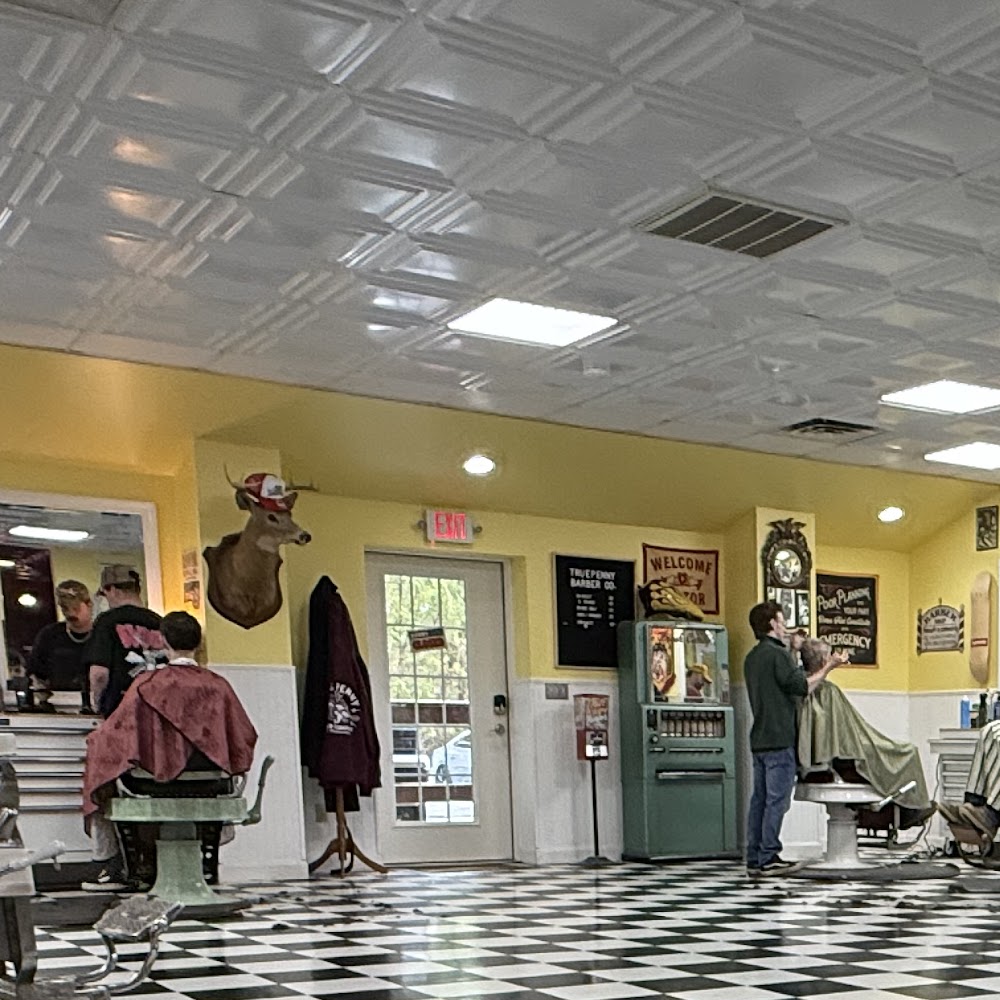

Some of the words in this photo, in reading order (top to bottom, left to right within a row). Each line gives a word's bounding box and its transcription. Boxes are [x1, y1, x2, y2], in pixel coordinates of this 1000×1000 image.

[434, 511, 466, 539] EXIT
[568, 567, 616, 581] TRUEPENNY
[650, 556, 712, 576] WELCOME
[570, 577, 601, 589] BARBER
